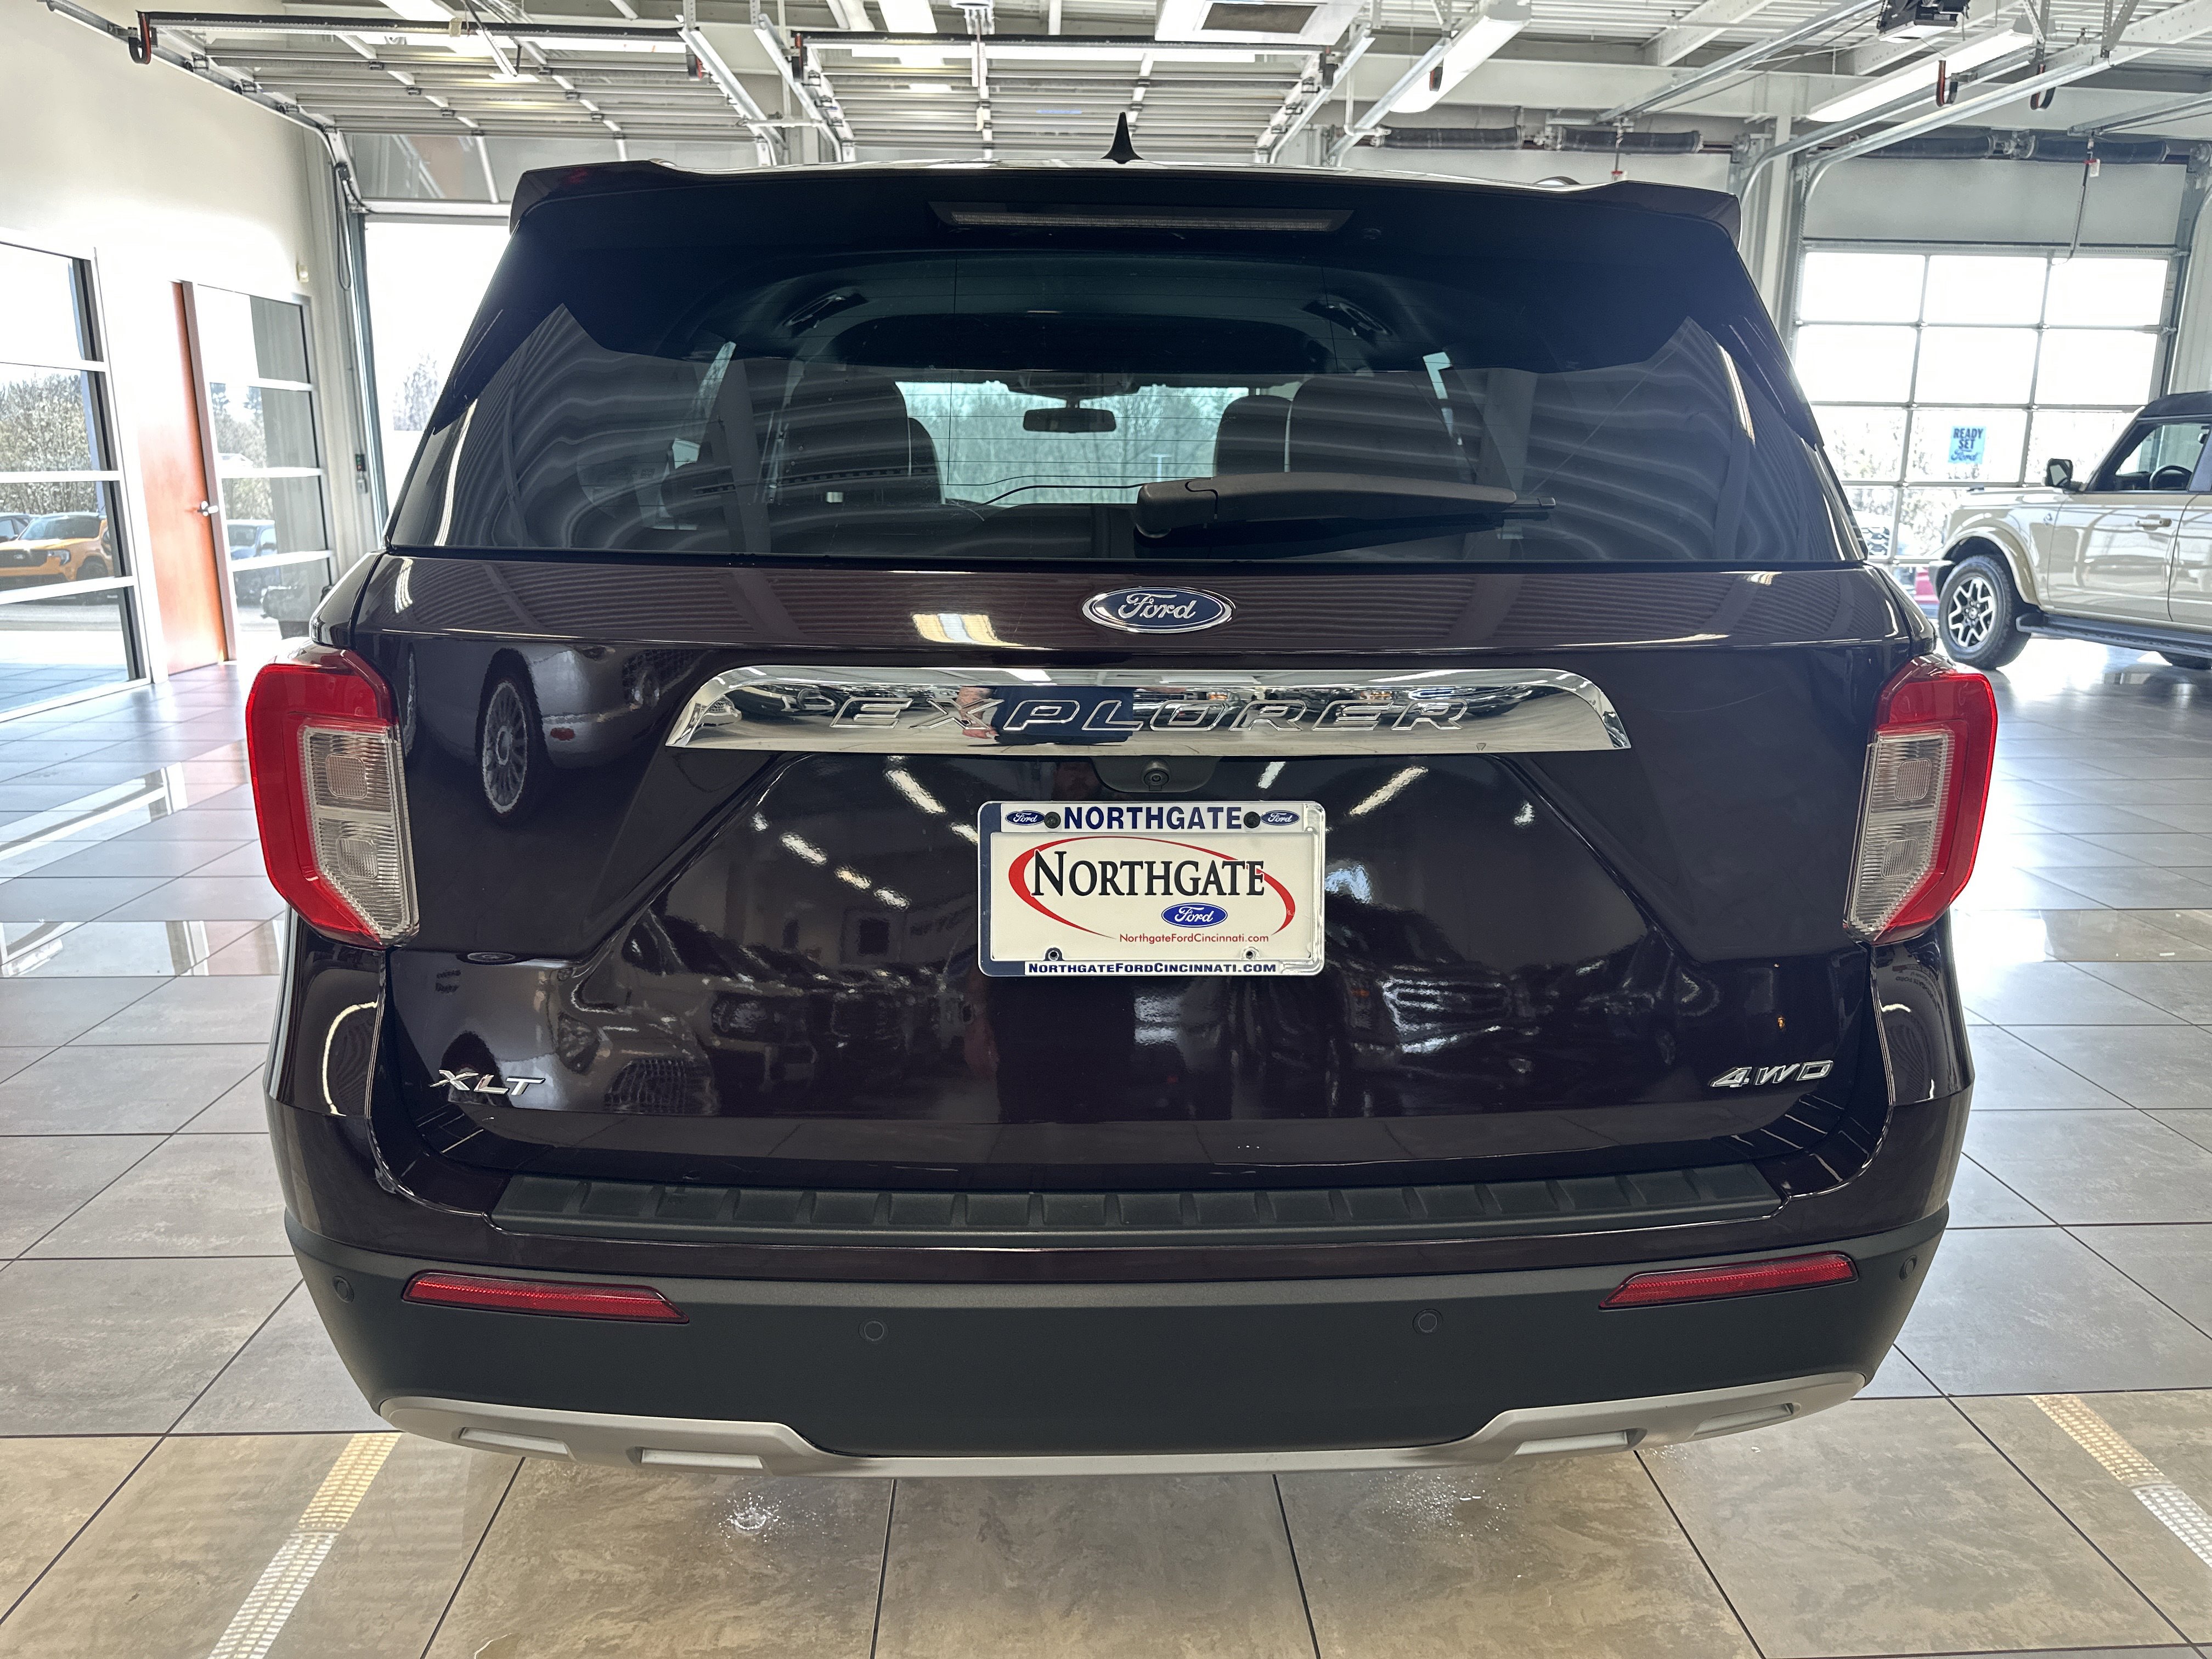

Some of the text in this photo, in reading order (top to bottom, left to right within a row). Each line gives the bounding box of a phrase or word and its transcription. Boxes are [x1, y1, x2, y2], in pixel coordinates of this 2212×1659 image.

[1953, 428, 1984, 439] READY
[1958, 439, 1976, 449] SET
[1118, 592, 1198, 619] Ford
[829, 697, 1469, 731] EXPLORER
[1013, 812, 1038, 823] Ford
[1064, 806, 1242, 830] NORTHGATE
[1267, 812, 1293, 822] Ford
[1031, 850, 1265, 896] NORTHGATE
[1173, 906, 1214, 924] Ford
[1119, 933, 1269, 944] NorthgateFordCincinnati.com
[428, 1069, 546, 1096] XLT
[1707, 1059, 1834, 1088] 4WD
